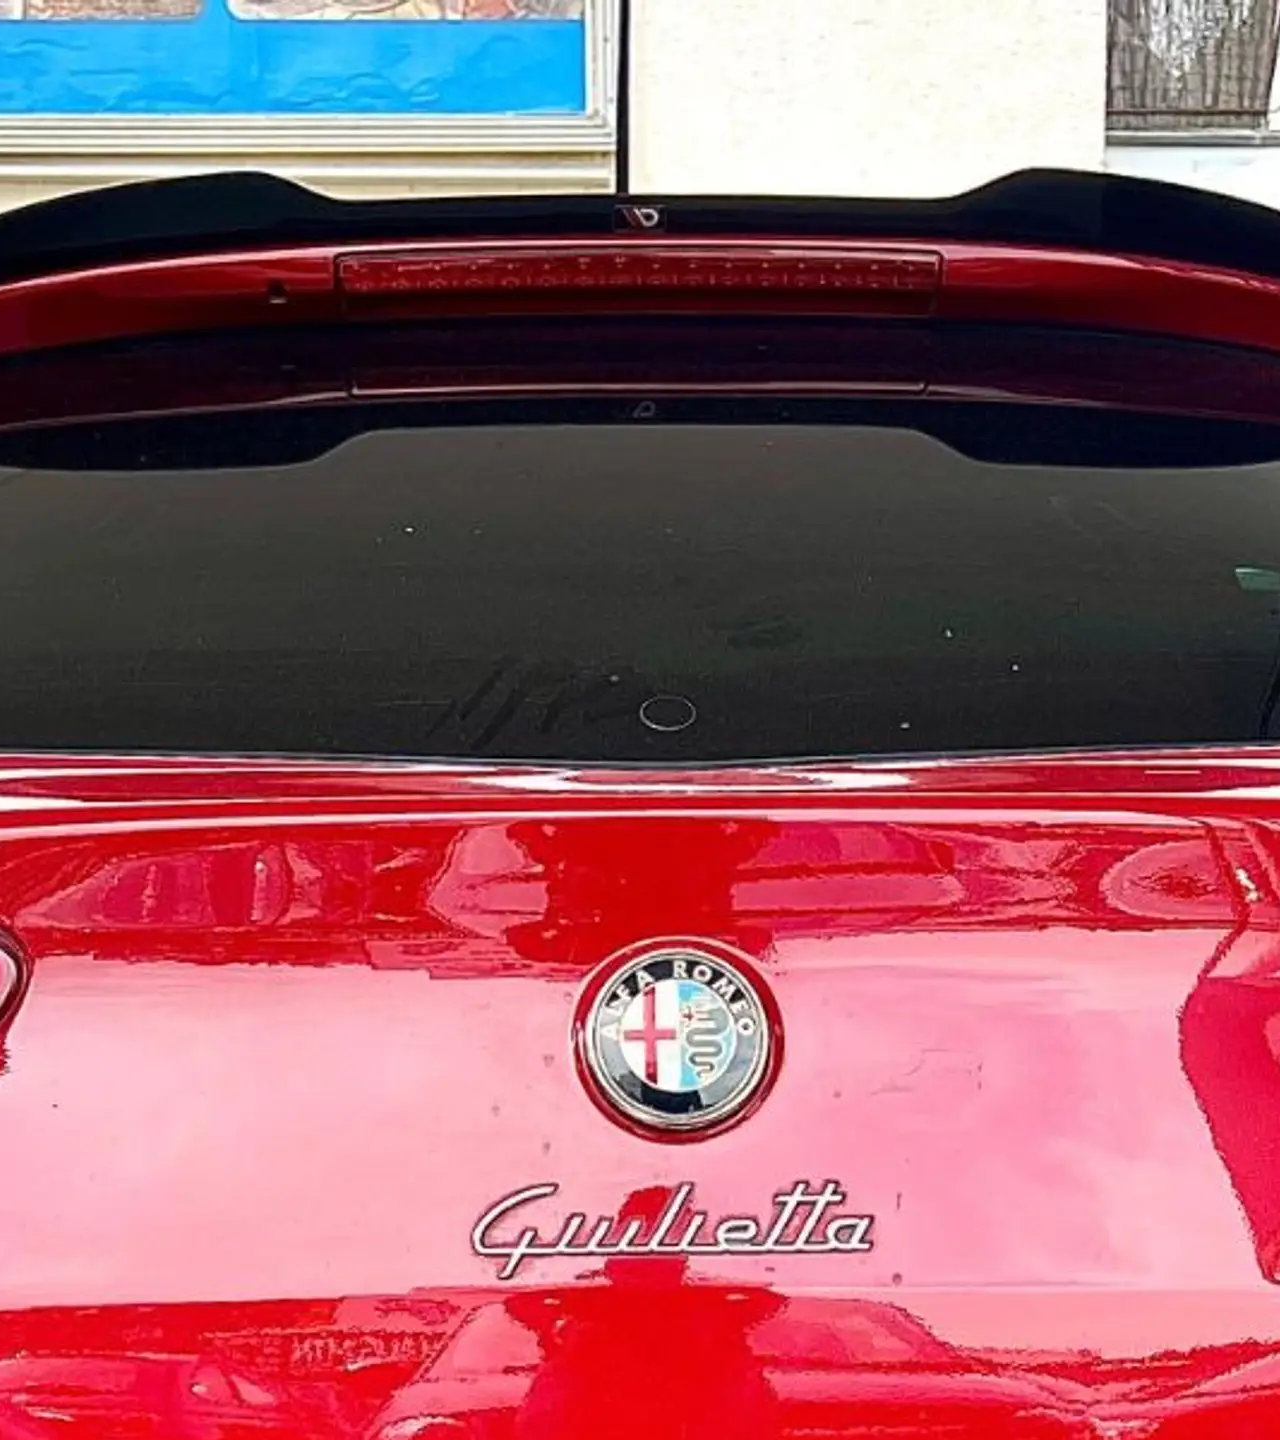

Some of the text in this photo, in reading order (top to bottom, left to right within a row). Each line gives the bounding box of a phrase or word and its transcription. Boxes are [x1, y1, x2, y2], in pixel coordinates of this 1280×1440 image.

[598, 960, 755, 1041] ALFA ROMEO
[471, 1180, 875, 1280] Giulietta
